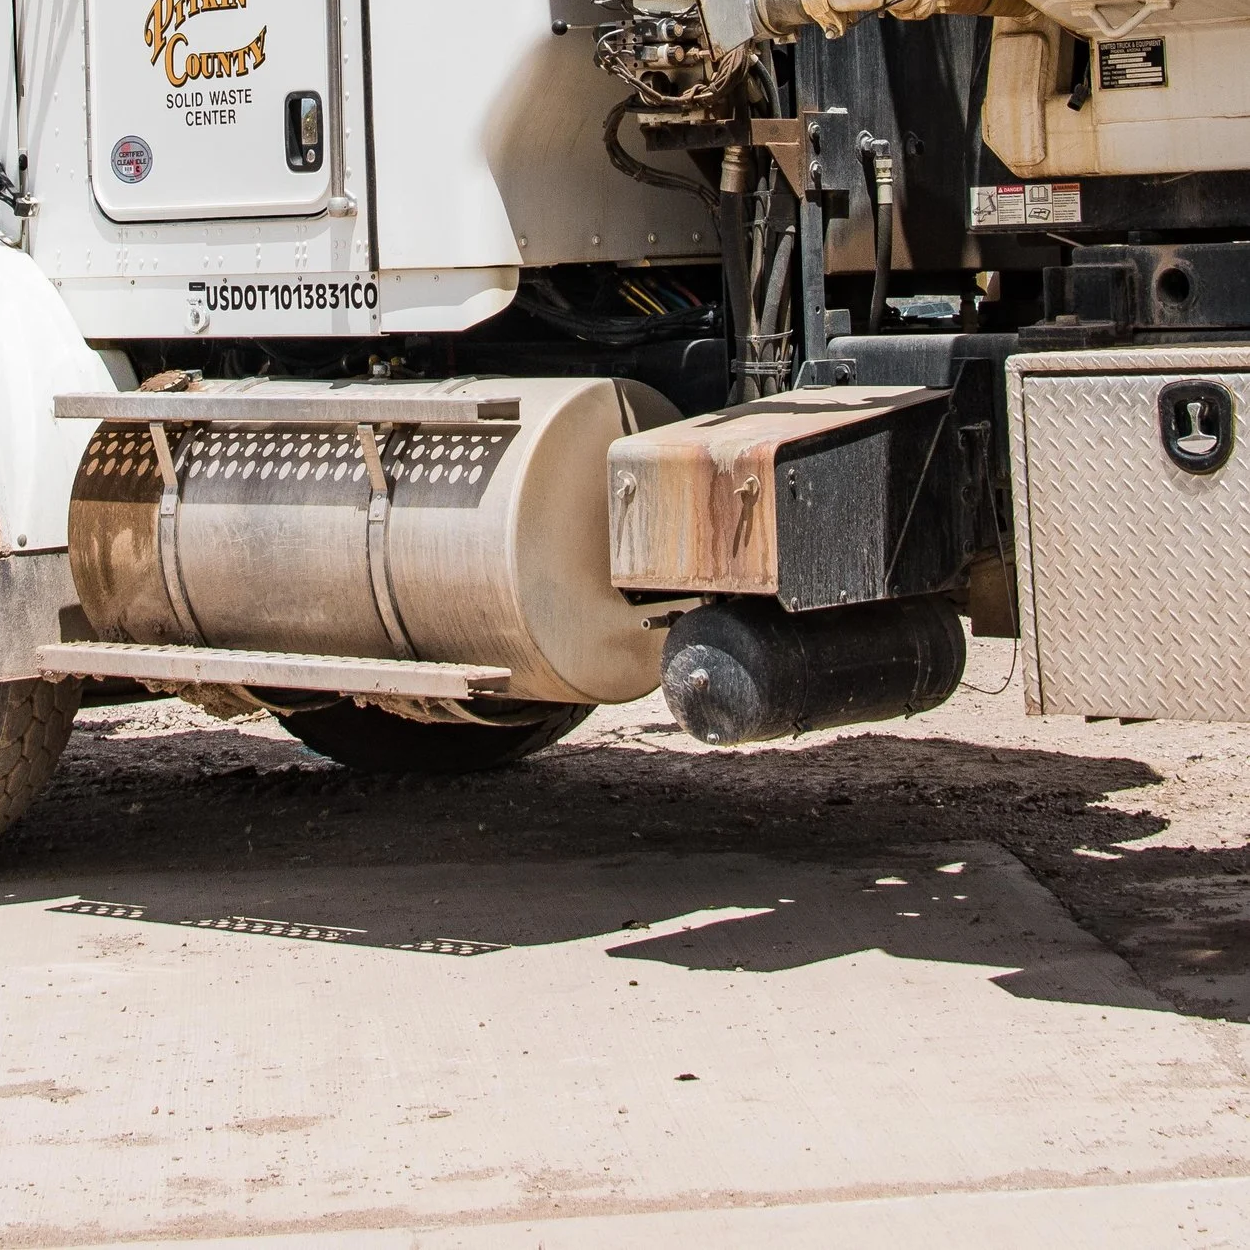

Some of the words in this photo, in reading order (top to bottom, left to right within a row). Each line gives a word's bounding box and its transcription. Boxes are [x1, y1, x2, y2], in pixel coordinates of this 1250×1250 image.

[166, 92, 203, 109] SOLID
[209, 88, 252, 106] WASTE
[185, 109, 236, 126] CENTER
[206, 282, 378, 311] USDOT1013831CO
